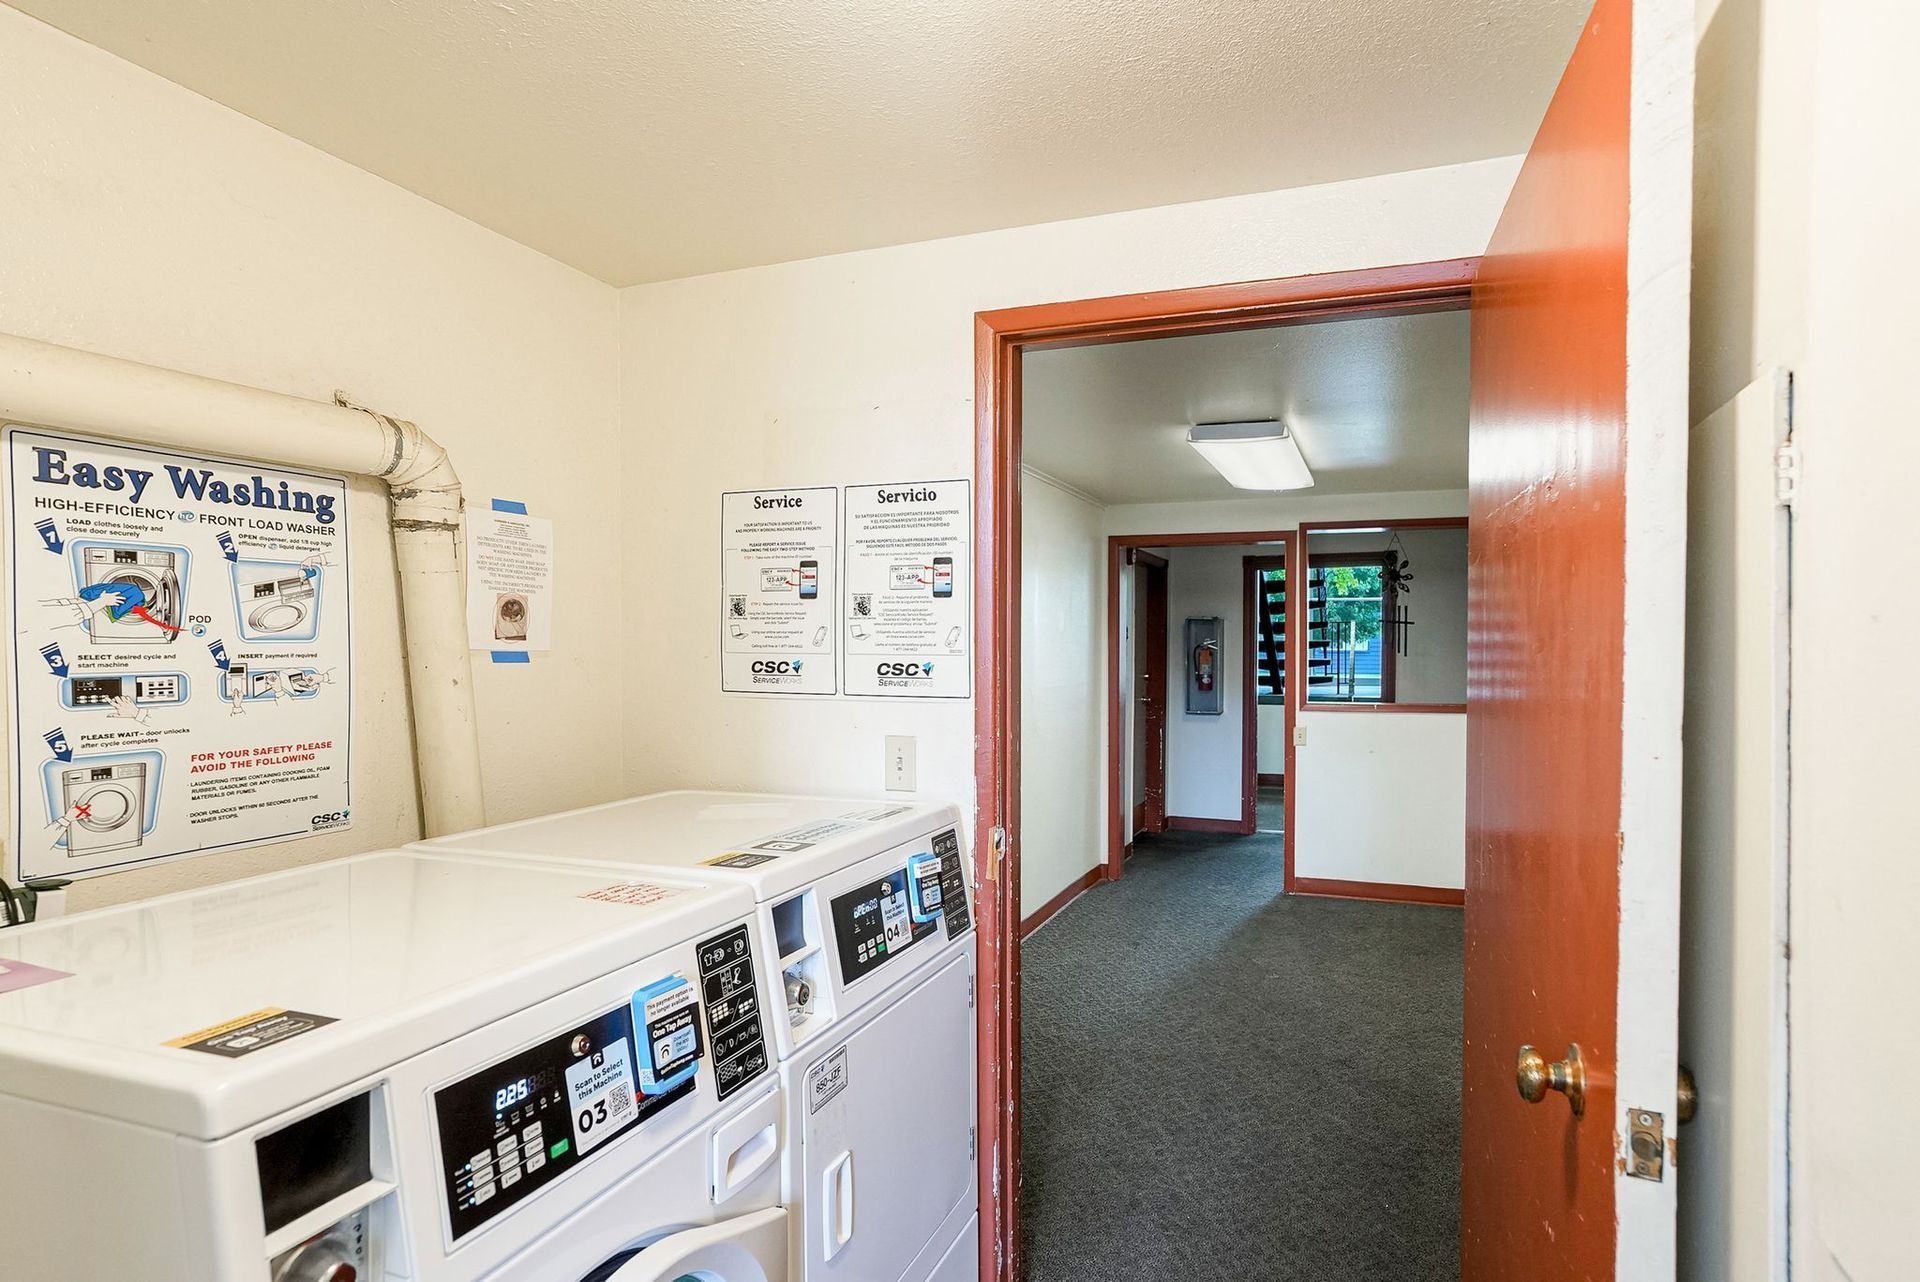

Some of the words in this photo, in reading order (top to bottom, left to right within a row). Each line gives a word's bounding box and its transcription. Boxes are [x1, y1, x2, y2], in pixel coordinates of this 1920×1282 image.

[32, 446, 153, 504] Easy
[164, 464, 337, 524] Washing
[754, 494, 802, 510] Service
[877, 488, 937, 504] Servicio
[34, 496, 176, 520] HIGH-EFFICIENCY
[200, 514, 245, 528] FRONT
[248, 519, 284, 532] LOAD
[286, 523, 336, 536] WASHER
[94, 520, 121, 528] clothes
[123, 522, 149, 531] loosely
[46, 530, 56, 543] 1
[109, 529, 140, 538] securely
[224, 542, 234, 553] 2
[188, 615, 212, 624] POD
[50, 655, 62, 667] 3
[751, 660, 790, 674] CSC
[877, 662, 920, 676] CSC
[54, 740, 66, 753] 5
[122, 738, 159, 746] completes
[191, 753, 215, 762] FOR
[218, 749, 250, 760] YOUR
[252, 745, 293, 756] SAFETY
[296, 741, 332, 751] PLEASE
[190, 763, 226, 774] AVOID
[230, 760, 253, 769] THE
[256, 752, 315, 766] FOLLOWING
[311, 812, 341, 825] CSC
[887, 923, 900, 942] 04
[652, 1028, 666, 1038] One
[665, 1022, 677, 1033] Tap
[677, 1014, 692, 1028] Away
[575, 1076, 593, 1092] Scan
[593, 1071, 601, 1080] to
[602, 1059, 624, 1076] Select
[578, 1087, 593, 1101] this
[593, 1070, 623, 1091] Machine
[578, 1099, 608, 1134] 03
